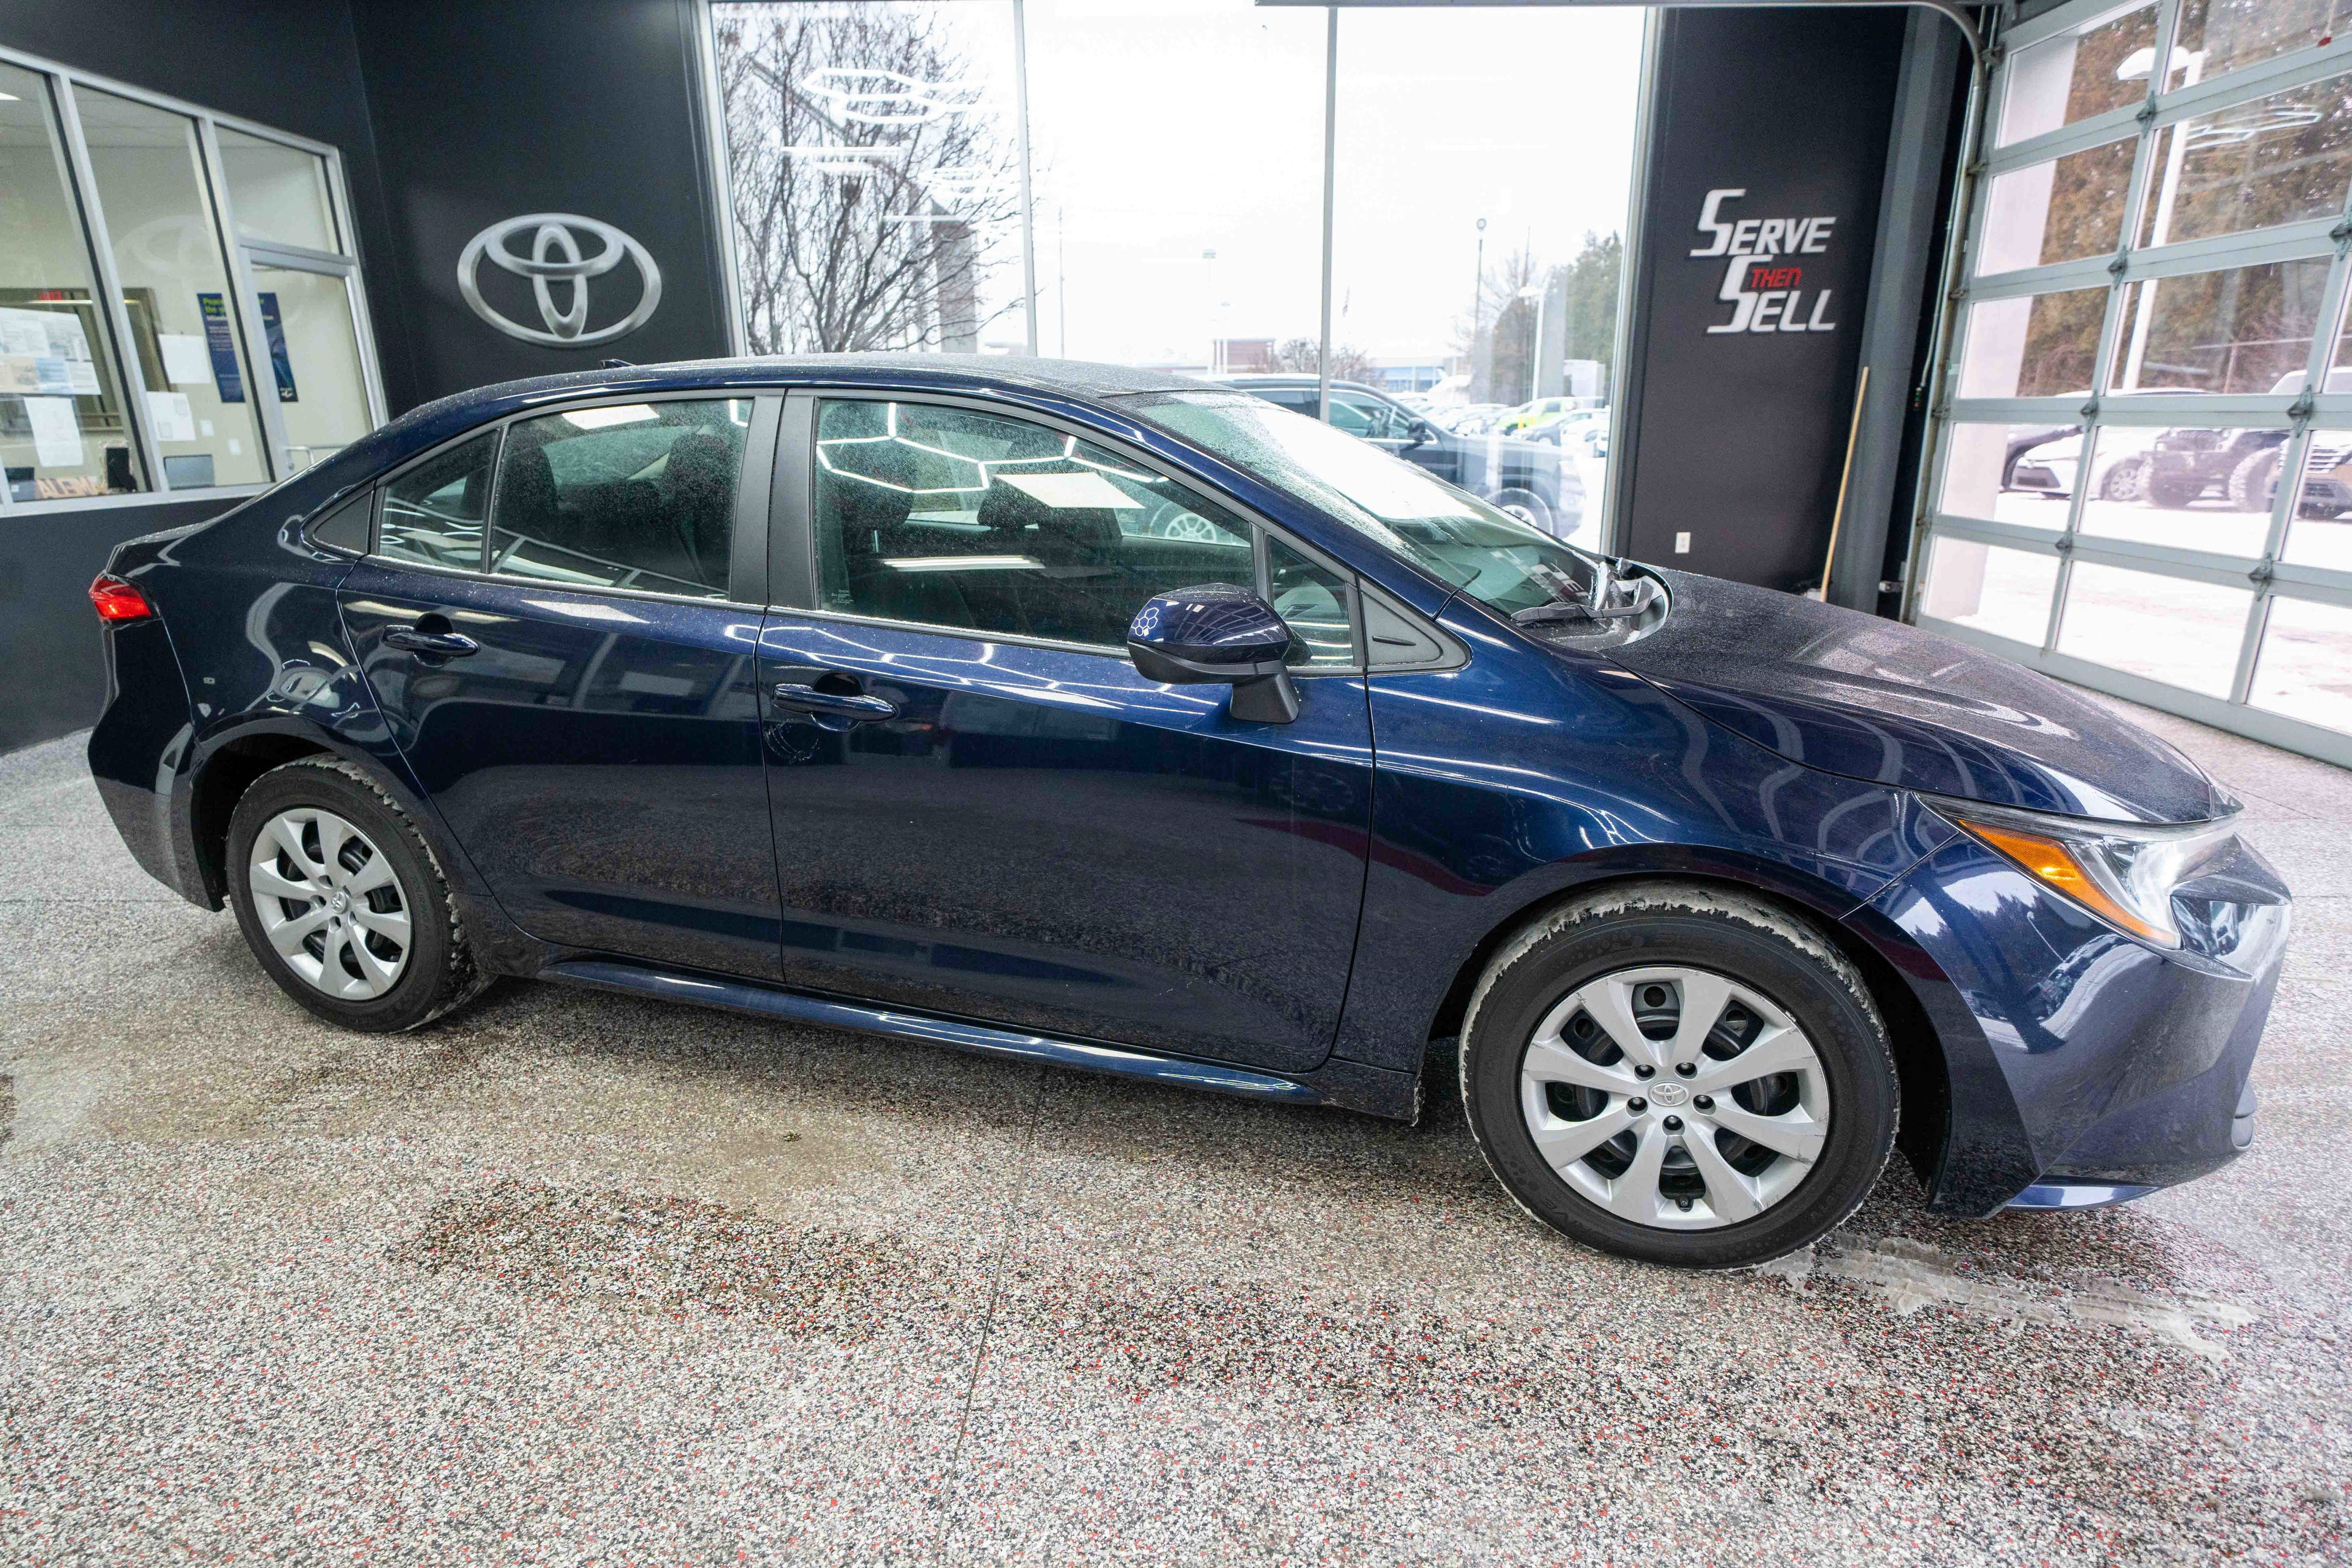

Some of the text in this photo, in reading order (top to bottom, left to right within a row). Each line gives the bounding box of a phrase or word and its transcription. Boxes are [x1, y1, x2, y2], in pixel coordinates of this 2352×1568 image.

[1690, 189, 1836, 256] SERVE
[1707, 254, 1836, 333] SELL
[1751, 268, 1801, 287] THEN
